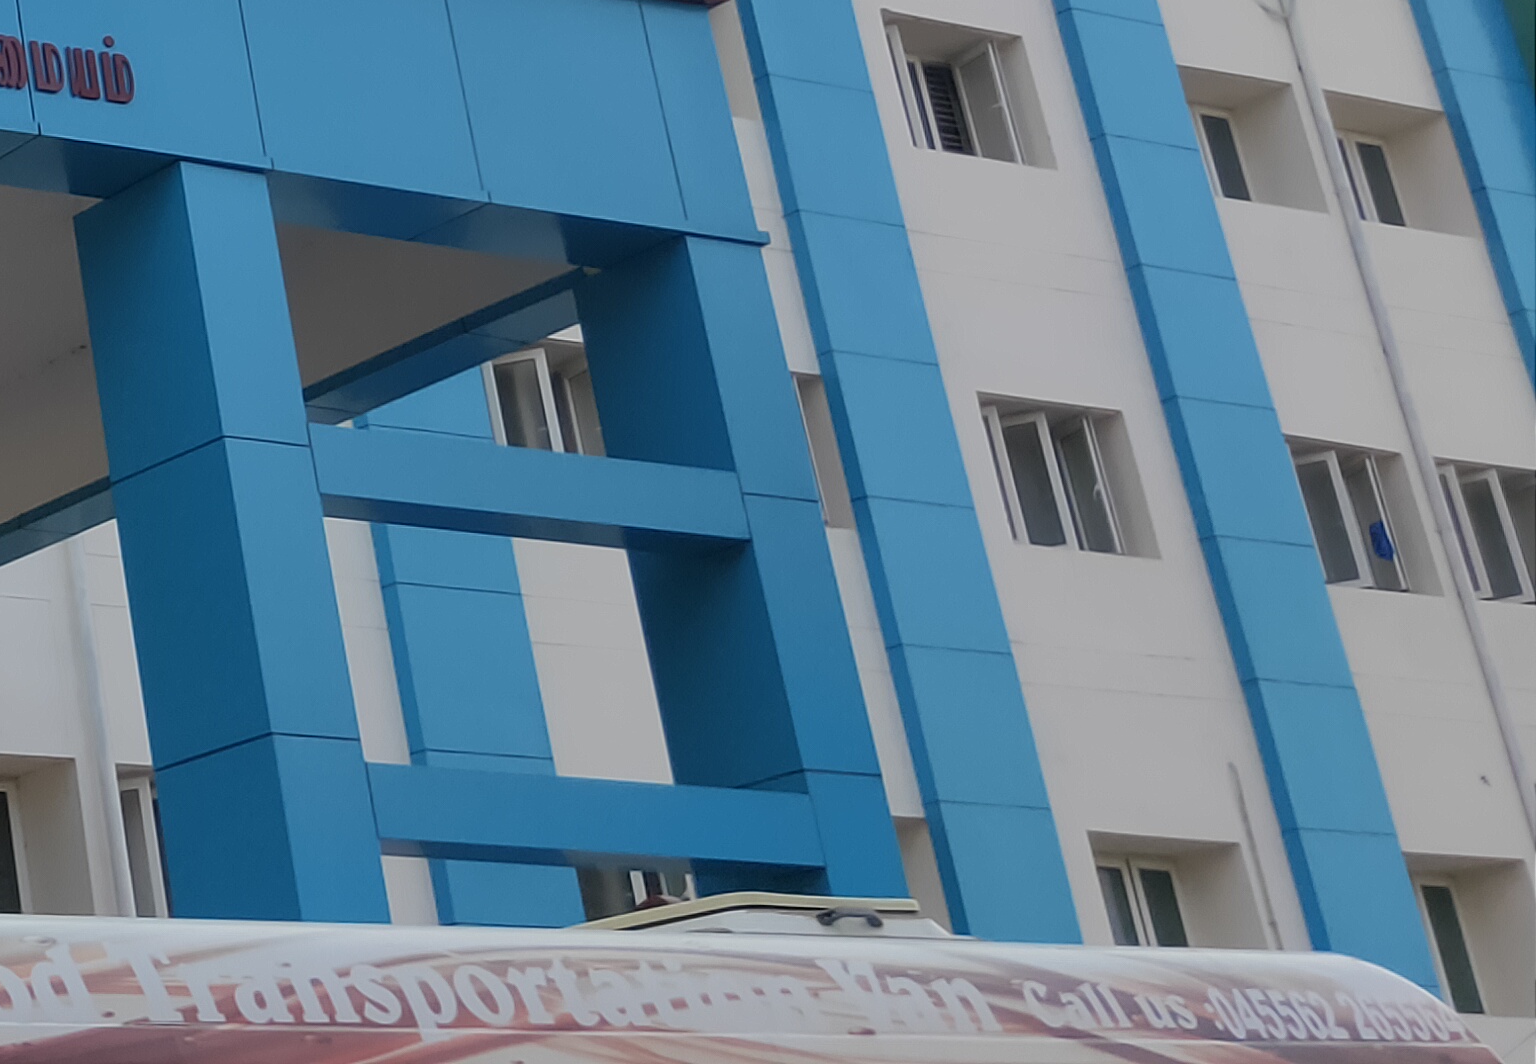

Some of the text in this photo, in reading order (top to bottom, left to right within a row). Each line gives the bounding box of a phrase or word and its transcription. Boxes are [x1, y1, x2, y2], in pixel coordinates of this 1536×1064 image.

[814, 958, 1003, 1033] Van
[1019, 980, 1136, 1030] Call
[1143, 993, 1198, 1030] us
